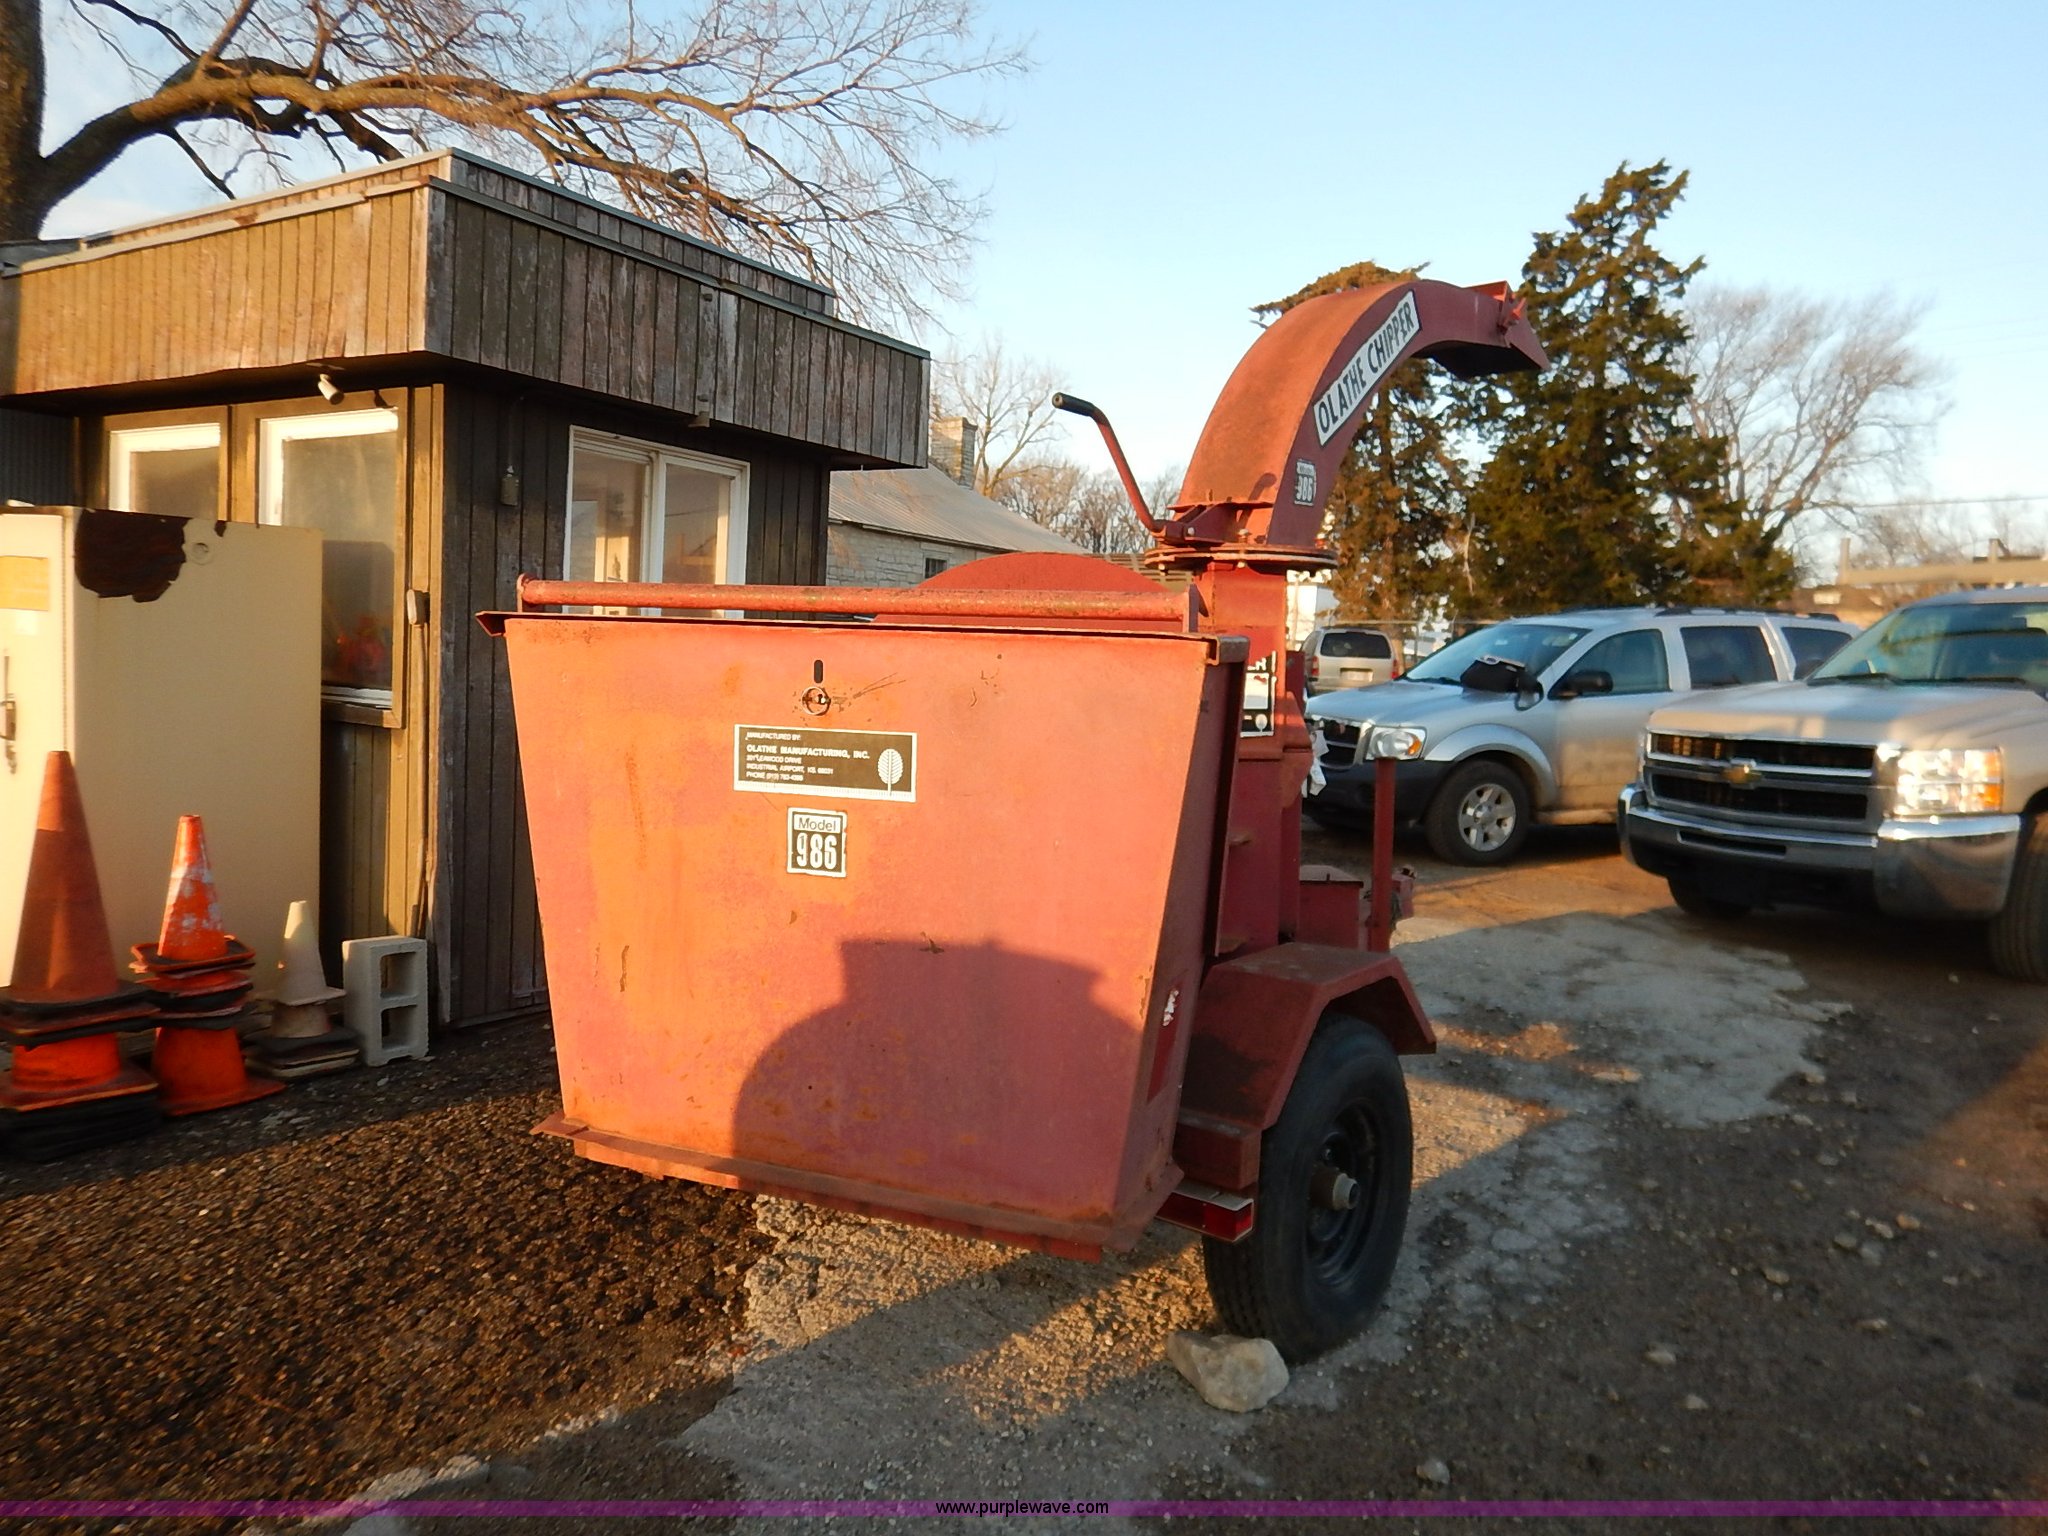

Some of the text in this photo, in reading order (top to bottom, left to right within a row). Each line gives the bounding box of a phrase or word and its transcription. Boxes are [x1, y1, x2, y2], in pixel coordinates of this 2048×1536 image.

[1318, 301, 1414, 434] OLATHE CHIPPER
[746, 744, 871, 759] OLATHE MANUFACTURING, INC.
[798, 817, 836, 832] Model
[796, 832, 837, 870] 986
